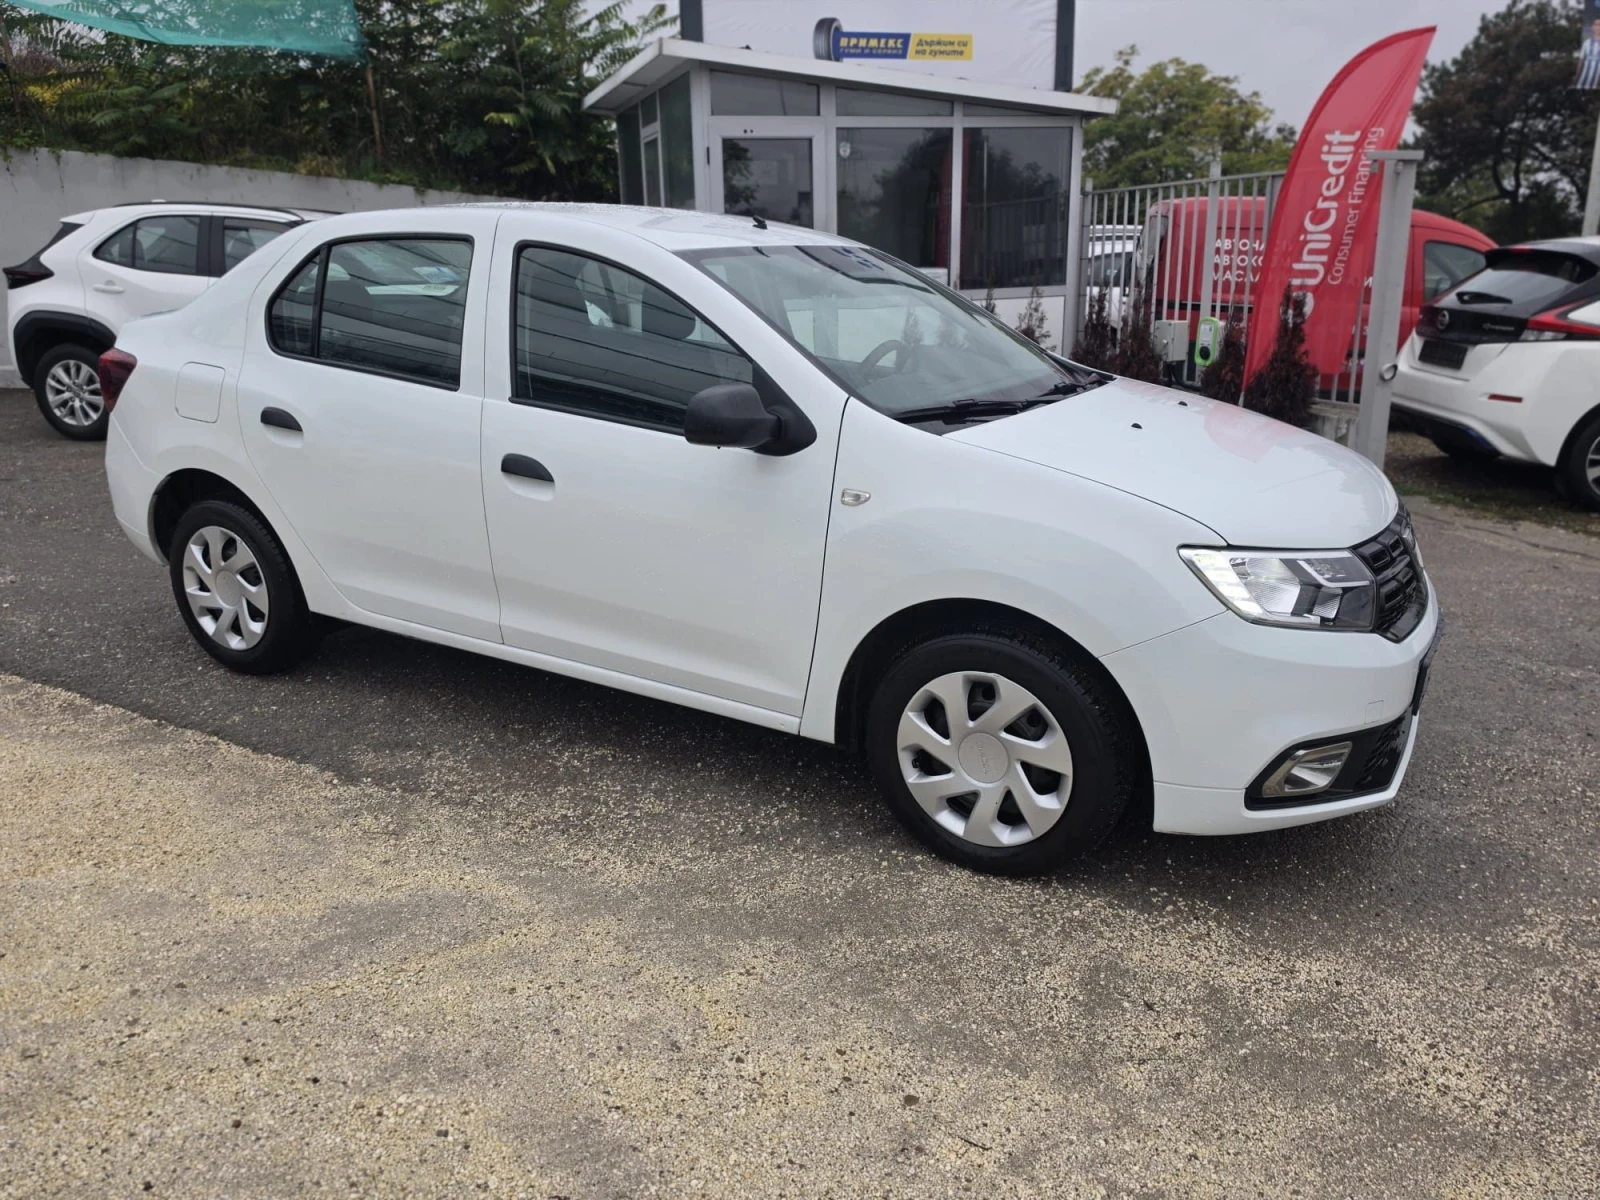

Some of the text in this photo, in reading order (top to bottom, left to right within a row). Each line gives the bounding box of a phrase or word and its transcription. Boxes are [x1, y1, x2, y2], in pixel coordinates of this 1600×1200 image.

[840, 37, 904, 48] ПРИМЕКС
[916, 38, 968, 49] Държим си
[928, 48, 965, 57] гумите
[1290, 130, 1361, 285] UniCredit
[1327, 208, 1359, 285] Consumer
